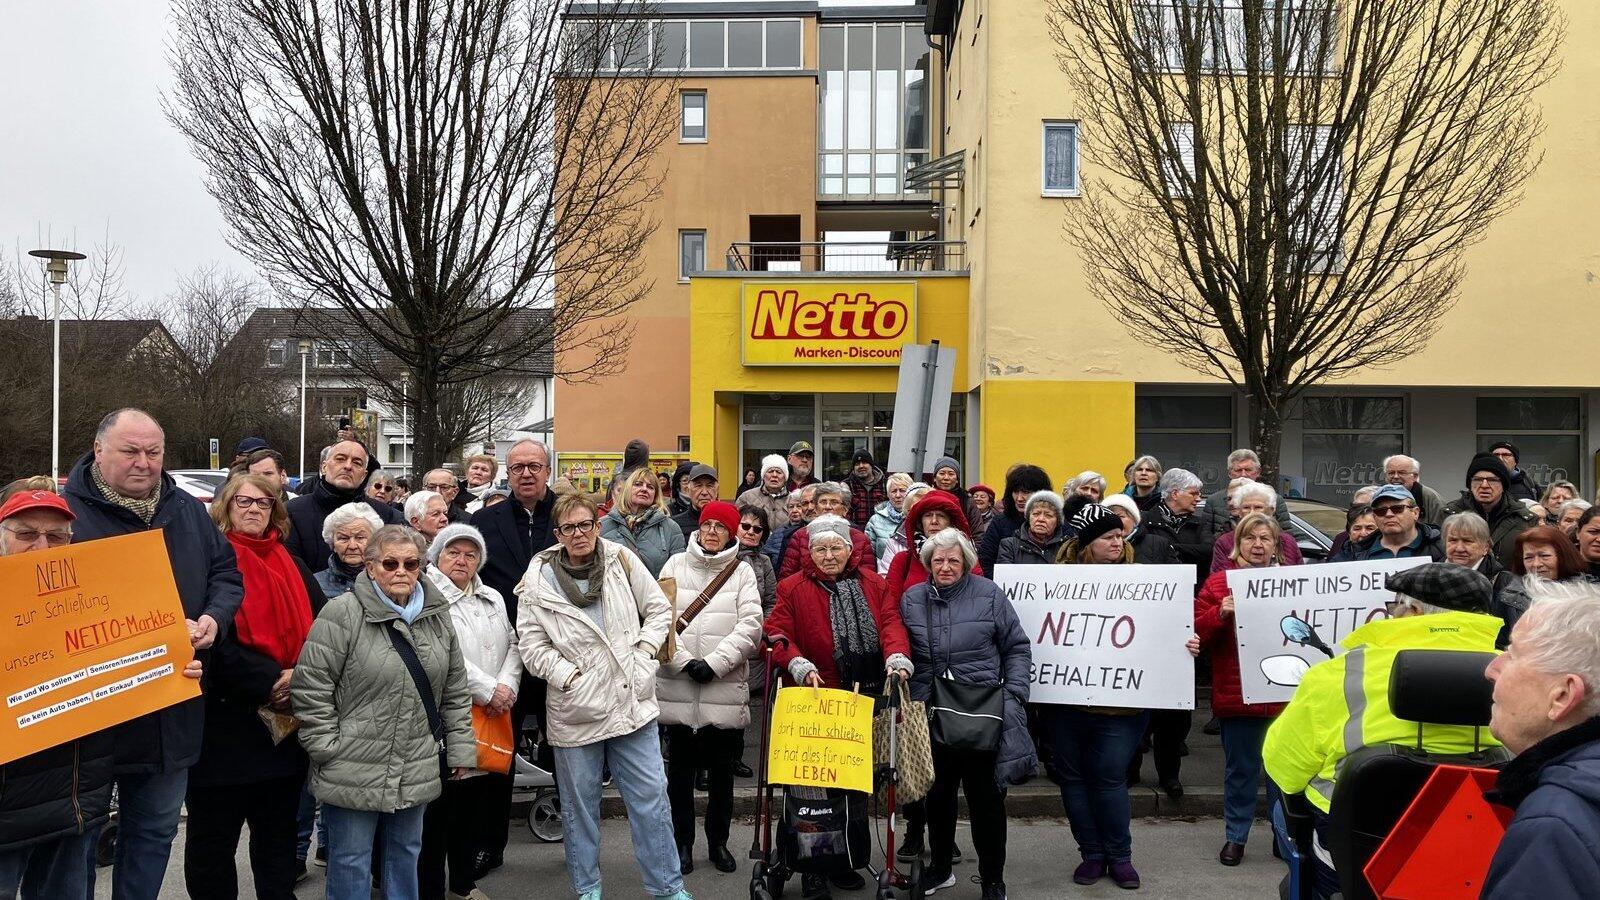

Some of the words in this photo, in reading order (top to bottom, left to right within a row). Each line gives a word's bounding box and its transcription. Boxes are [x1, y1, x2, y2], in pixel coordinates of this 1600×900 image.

[750, 290, 908, 340] Netto
[794, 346, 903, 358] Marken-Discoun
[36, 557, 78, 593] NEIN
[1003, 581, 1037, 601] WIR
[1044, 581, 1101, 601] WOLLEN
[1106, 582, 1178, 601] UNSEREN
[1246, 578, 1309, 599] NEHMT
[1315, 575, 1352, 595] UNS
[14, 610, 37, 627] zur
[45, 593, 111, 619] Schließung
[1037, 611, 1136, 649] NETTO
[4, 649, 55, 672] unseres
[9, 695, 23, 704] Wie
[24, 689, 38, 699] und
[38, 684, 50, 694] Wo
[51, 676, 73, 689] sollen
[73, 670, 85, 680] wir
[140, 651, 152, 660] und
[19, 716, 31, 726] die
[32, 710, 48, 721] kein
[49, 704, 66, 715] Auto
[67, 695, 91, 708] haben,
[95, 689, 108, 699] den
[109, 680, 134, 694] Einkauf
[786, 701, 812, 714] Unser
[777, 721, 794, 736] darf
[800, 721, 820, 737] nicht
[826, 722, 864, 741] schließen
[784, 743, 798, 761] hat
[802, 745, 820, 763] alles
[824, 746, 837, 766] für
[794, 765, 837, 783] LEBEN
